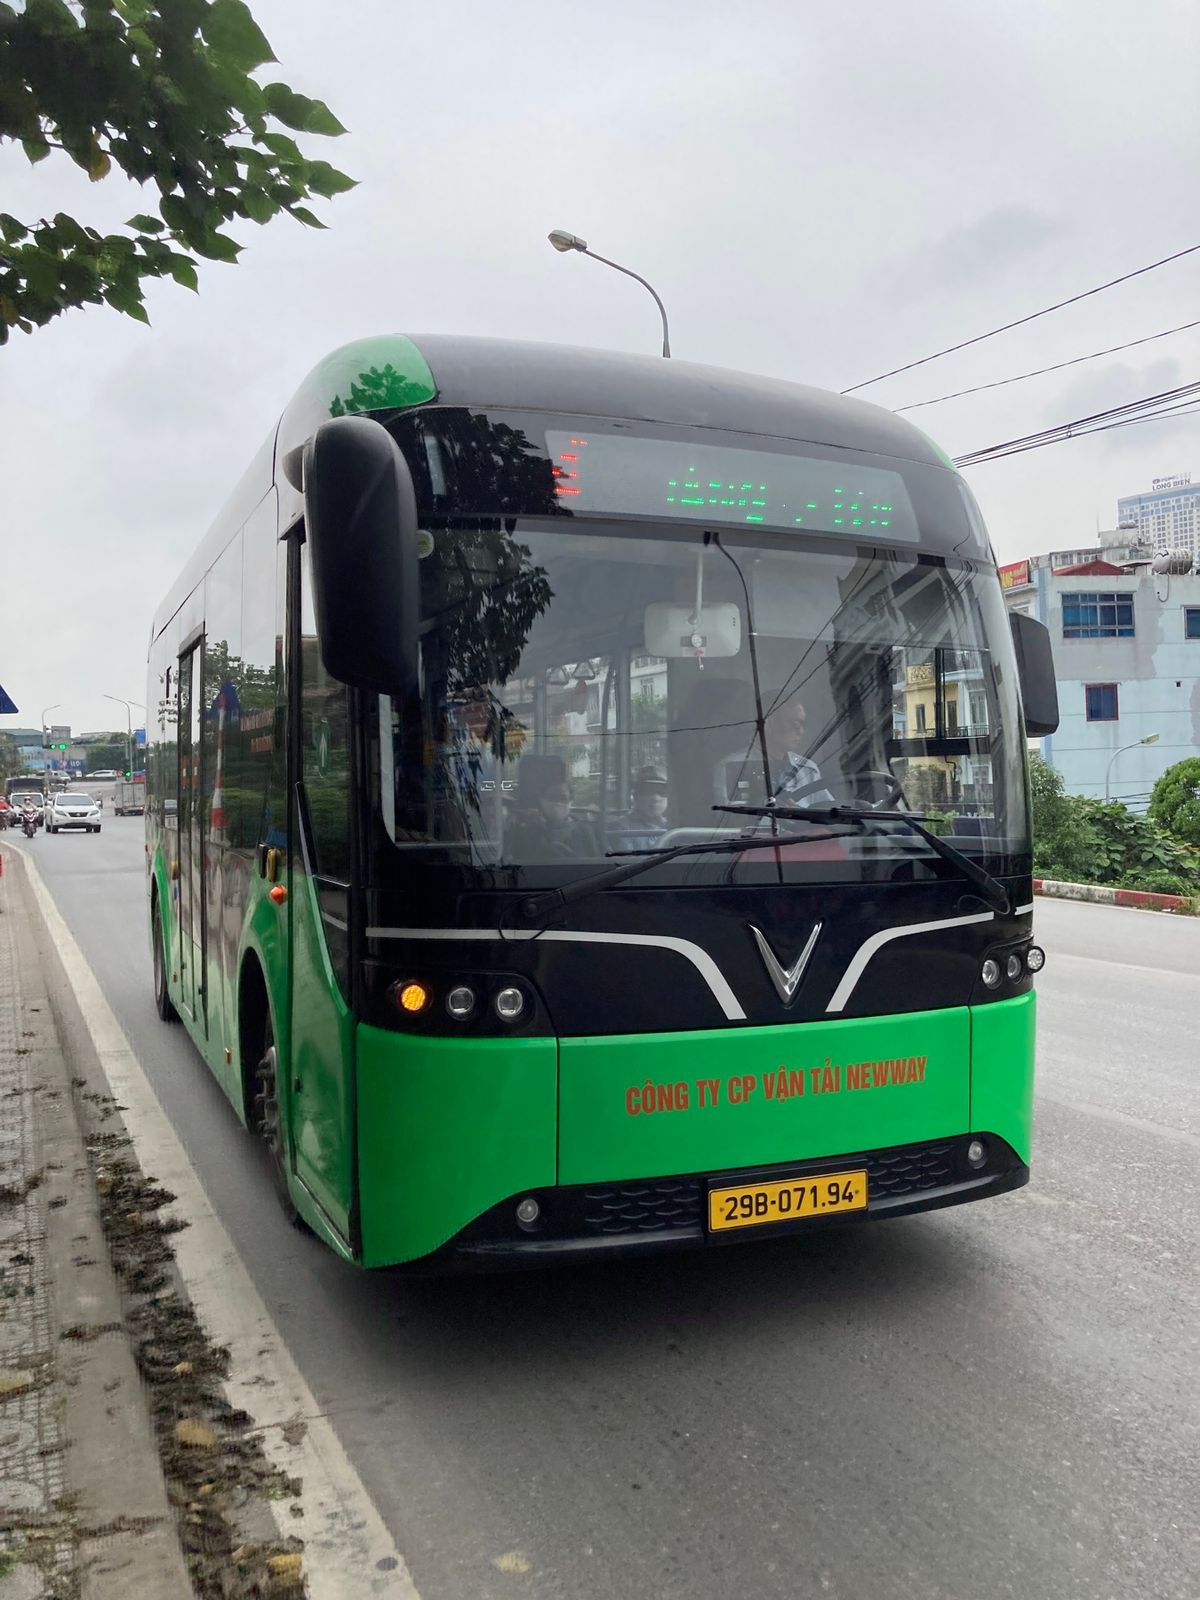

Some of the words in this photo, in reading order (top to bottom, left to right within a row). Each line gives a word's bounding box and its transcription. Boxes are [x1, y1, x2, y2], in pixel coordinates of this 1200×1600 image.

[626, 1079, 689, 1115] CÔNG
[696, 1079, 721, 1107] TY
[728, 1075, 756, 1105] CP
[763, 1066, 804, 1104] VẬN
[811, 1058, 840, 1094] TẢI
[847, 1056, 928, 1090] NEWWAY
[725, 1180, 854, 1221] 29B-071.94
